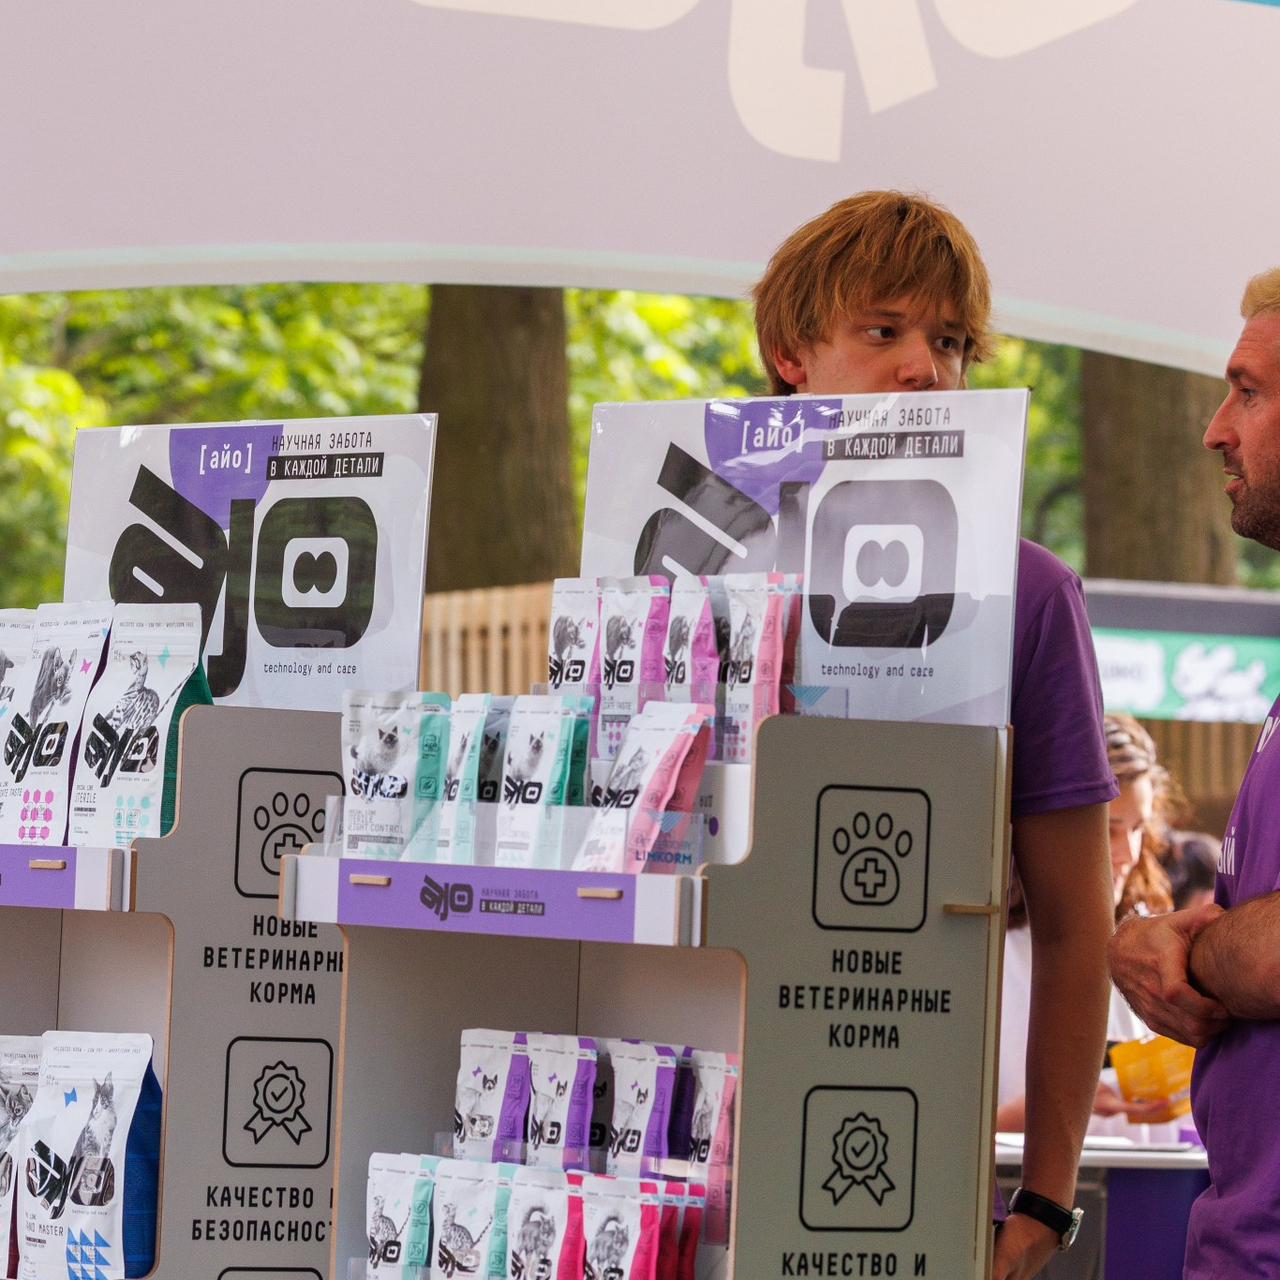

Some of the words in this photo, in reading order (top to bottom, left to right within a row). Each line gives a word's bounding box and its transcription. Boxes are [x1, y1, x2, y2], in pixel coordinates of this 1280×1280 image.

[829, 408, 889, 428] НАУЧНАЯ
[899, 406, 951, 426] ЗАБОТА
[271, 433, 322, 452] НАУЧНАЯ
[329, 431, 372, 449] ЗАБОТА
[827, 438, 835, 457] В
[845, 432, 896, 458] КАЖДОЙ
[903, 434, 959, 458] ДЕТАЛИ
[270, 460, 277, 476] В
[284, 455, 327, 478] КАЖДОЙ
[333, 456, 379, 477] ДЕТАЛИ
[263, 662, 313, 676] technology
[318, 662, 332, 674] and
[336, 664, 357, 674] care
[821, 663, 880, 679] technology
[886, 664, 904, 677] and
[910, 666, 934, 678] care
[253, 914, 318, 938] НОВЫЕ
[203, 947, 344, 973] ВЕТЕРИНАРН
[831, 949, 903, 975] НОВЫЕ
[249, 981, 316, 1005] КОРМА
[778, 986, 952, 1014] ВЕТЕРИНАРНЫЕ
[828, 1024, 901, 1049] КОРМА
[206, 1186, 314, 1209] КАЧЕСТВО
[38, 1223, 64, 1236] MASTER
[191, 1220, 333, 1243] БЕЗОПАСНОС
[782, 1252, 897, 1277] КАЧЕСТВО
[913, 1252, 927, 1275] И
